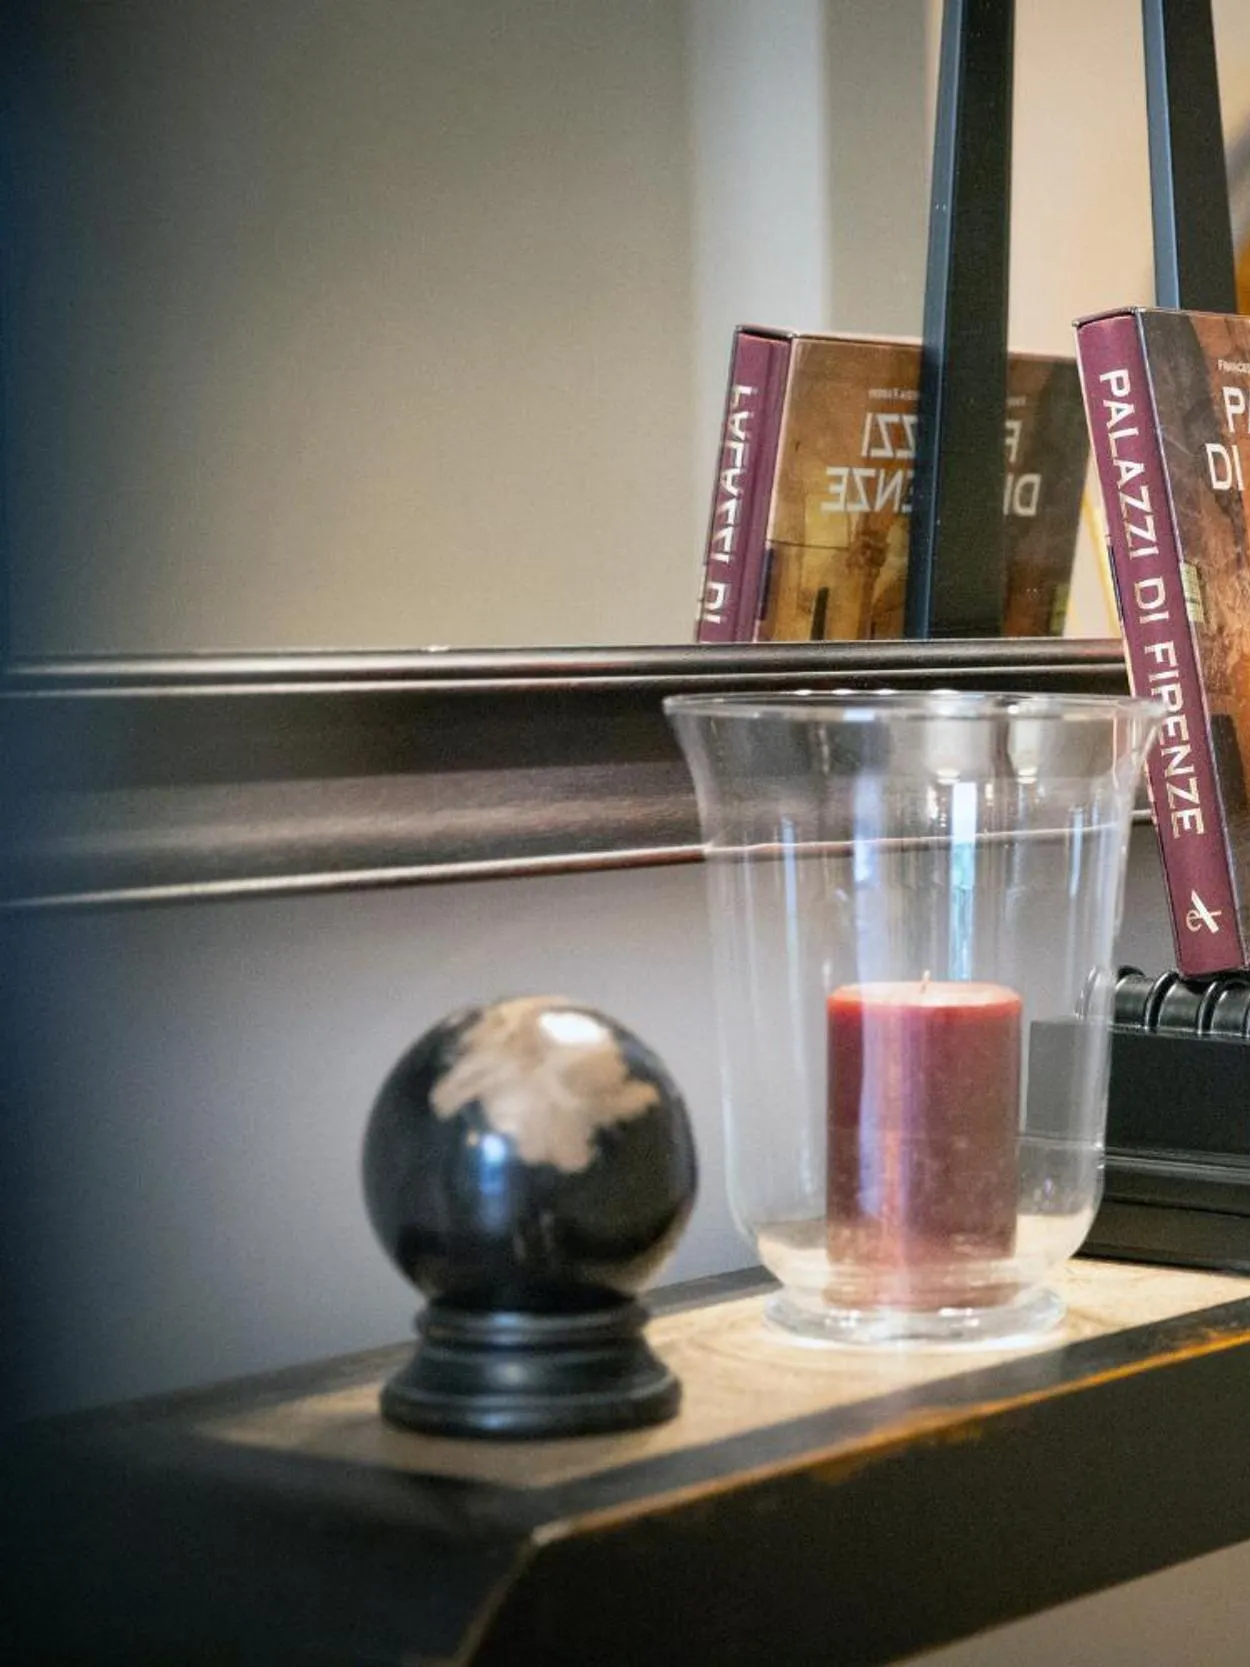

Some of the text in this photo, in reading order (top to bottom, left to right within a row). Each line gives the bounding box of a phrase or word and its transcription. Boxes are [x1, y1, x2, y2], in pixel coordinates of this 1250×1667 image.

[1100, 369, 1159, 560] PALAZZI
[1133, 576, 1169, 624] DI
[1205, 443, 1245, 491] DI
